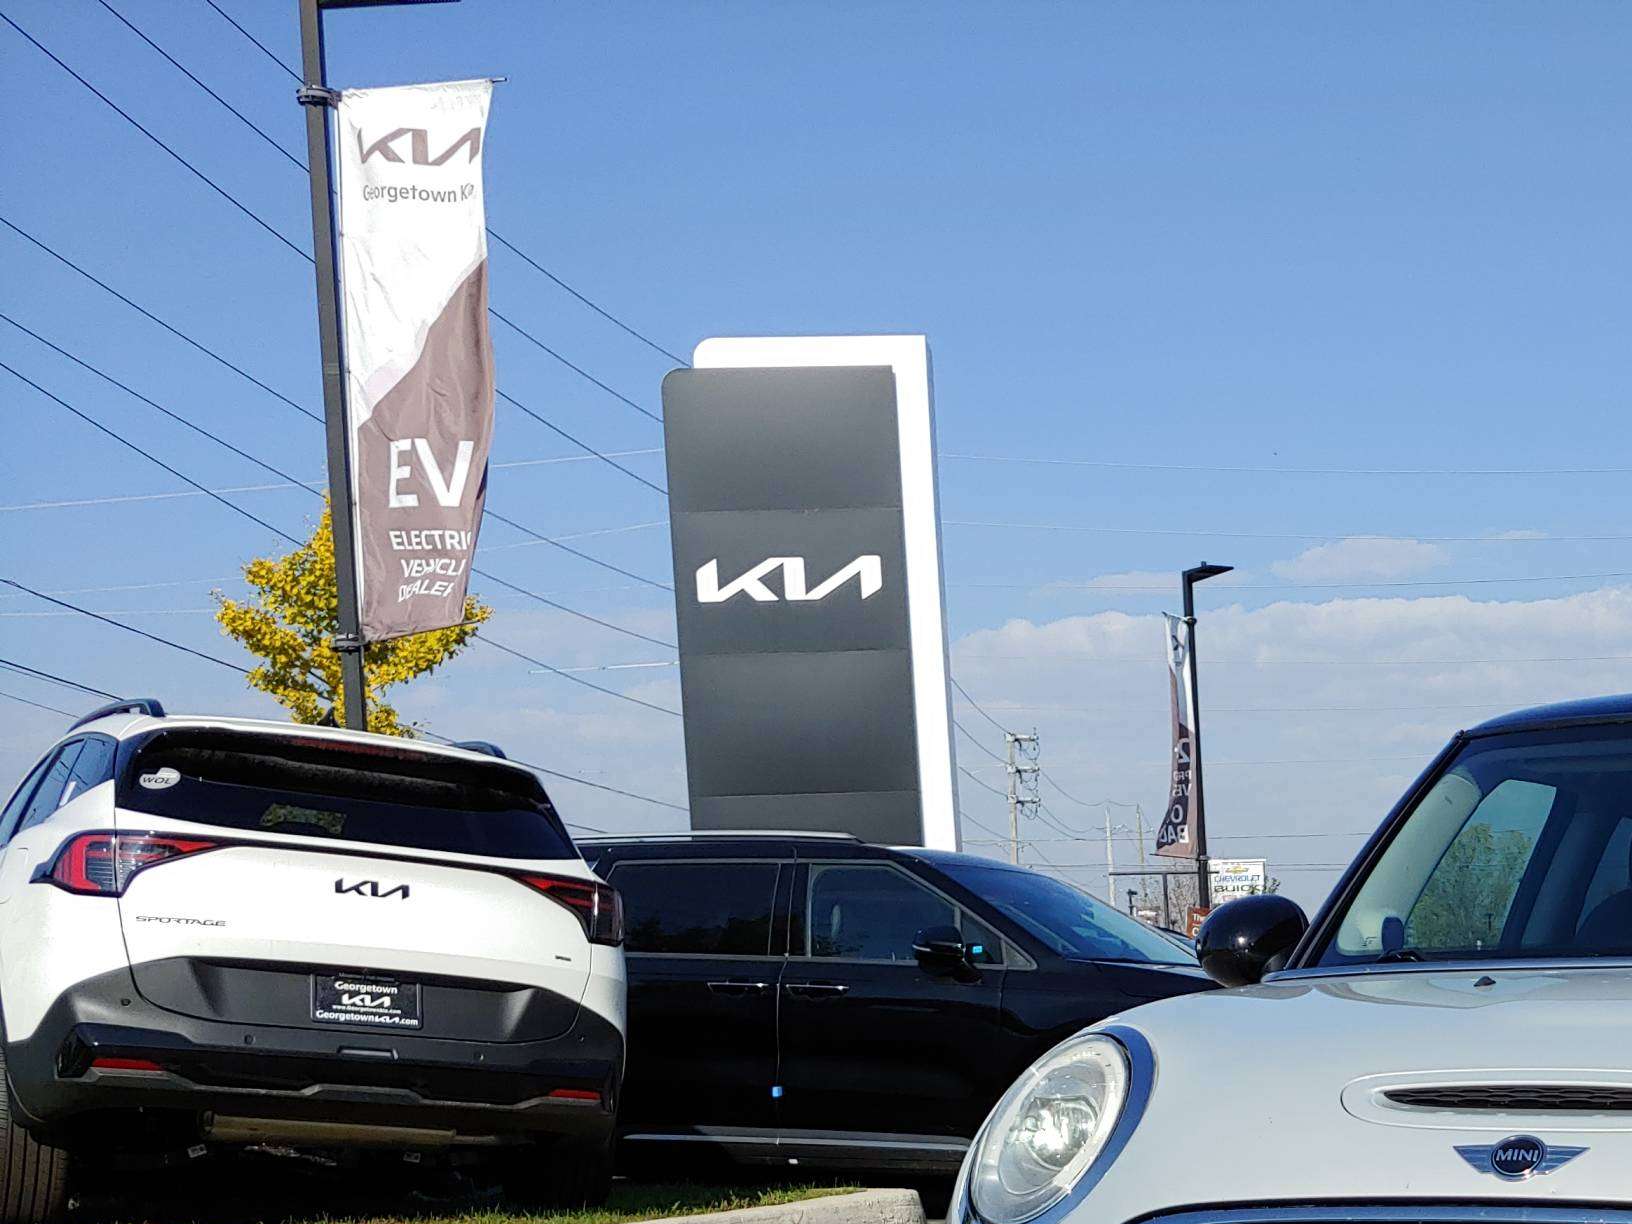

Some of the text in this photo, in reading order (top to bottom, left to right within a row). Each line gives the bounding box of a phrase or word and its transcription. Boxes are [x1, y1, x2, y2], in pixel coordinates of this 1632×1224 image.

[357, 127, 481, 166] KIA
[363, 184, 457, 203] Georgetown
[389, 437, 474, 508] EV
[696, 554, 883, 603] KIA
[334, 877, 410, 900] KIA
[135, 915, 227, 927] SPORTAGE
[334, 981, 398, 995] Georgetown
[341, 993, 391, 1007] KIA
[1495, 1148, 1539, 1162] MINI
